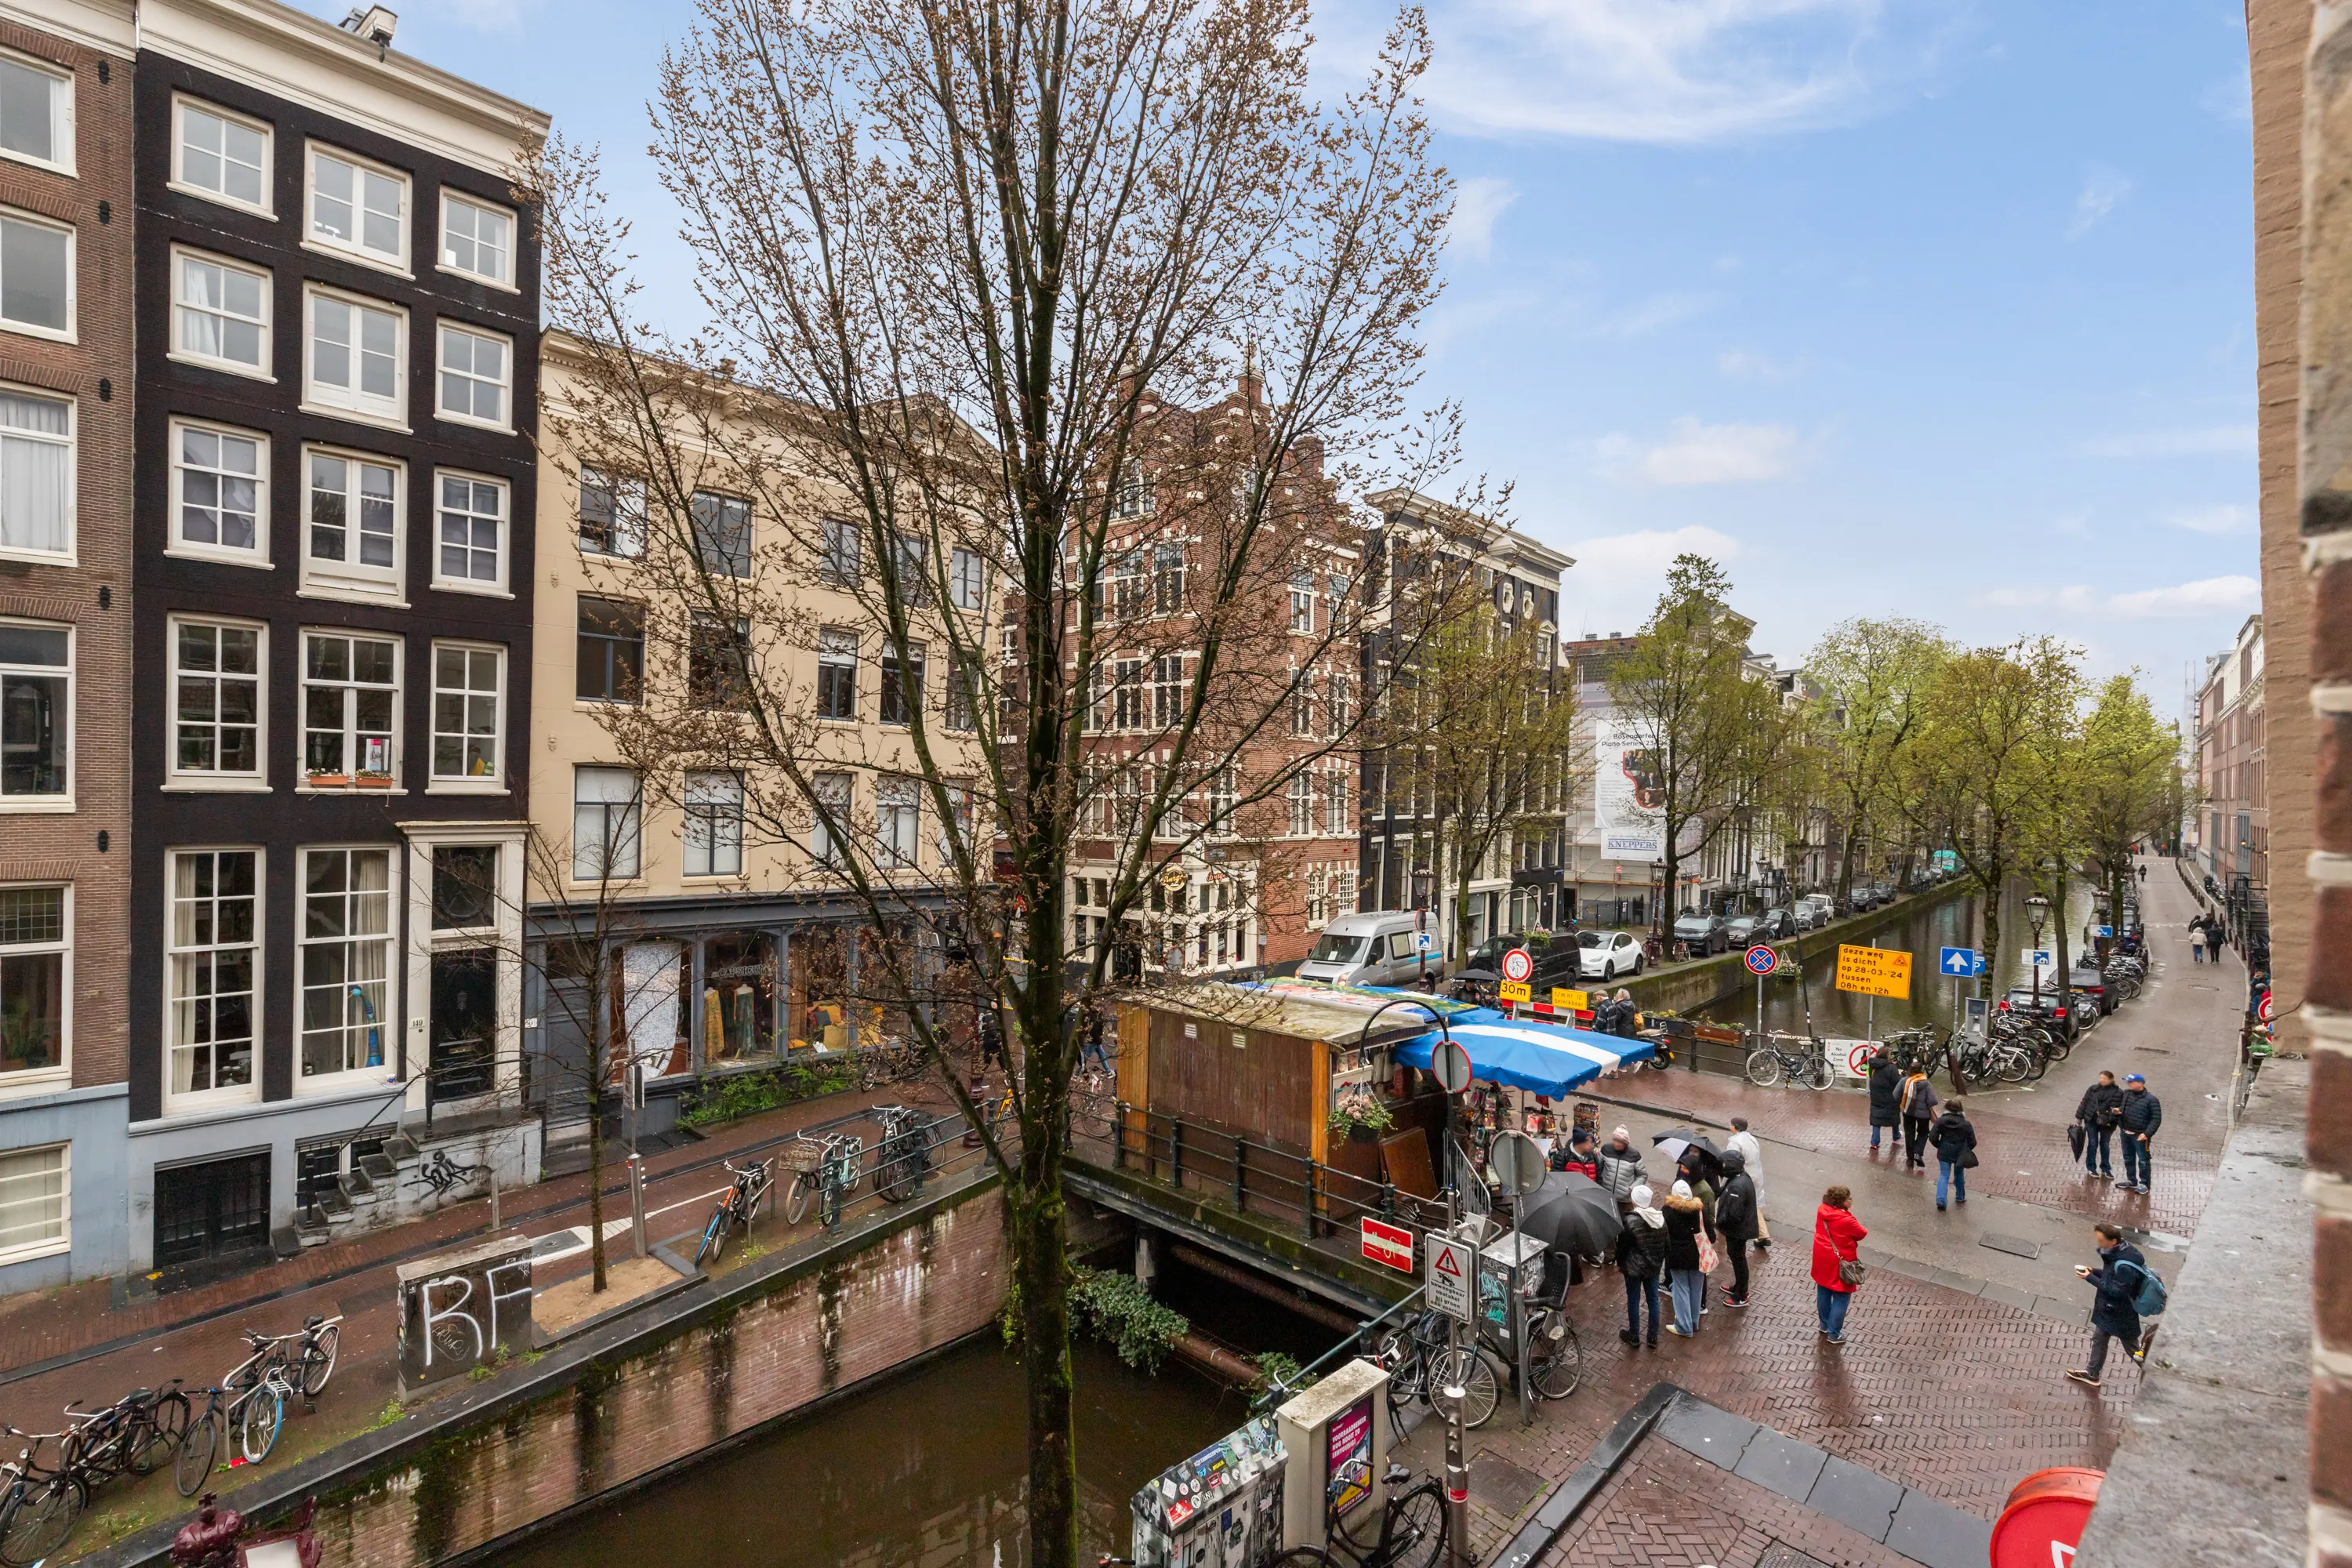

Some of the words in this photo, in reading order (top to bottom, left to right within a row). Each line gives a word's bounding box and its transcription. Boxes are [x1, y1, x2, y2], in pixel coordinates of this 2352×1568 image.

[1608, 840, 1657, 849] KNEPPERS
[1843, 947, 1864, 956] deze
[1867, 951, 1884, 960] weg
[1853, 957, 1877, 966] dicht
[1841, 973, 1871, 983] tussen
[1854, 966, 1903, 978] 28-03-'24
[1501, 982, 1526, 996] 30m
[1840, 982, 1857, 990] 08h
[1875, 986, 1889, 995] 12h
[1554, 998, 1584, 1007] bereikbaar
[1431, 1280, 1465, 1298] beweegbaar
[1436, 1290, 1460, 1302] obstakel
[1444, 1299, 1461, 1308] groen
[1443, 1305, 1465, 1319] voertuig
